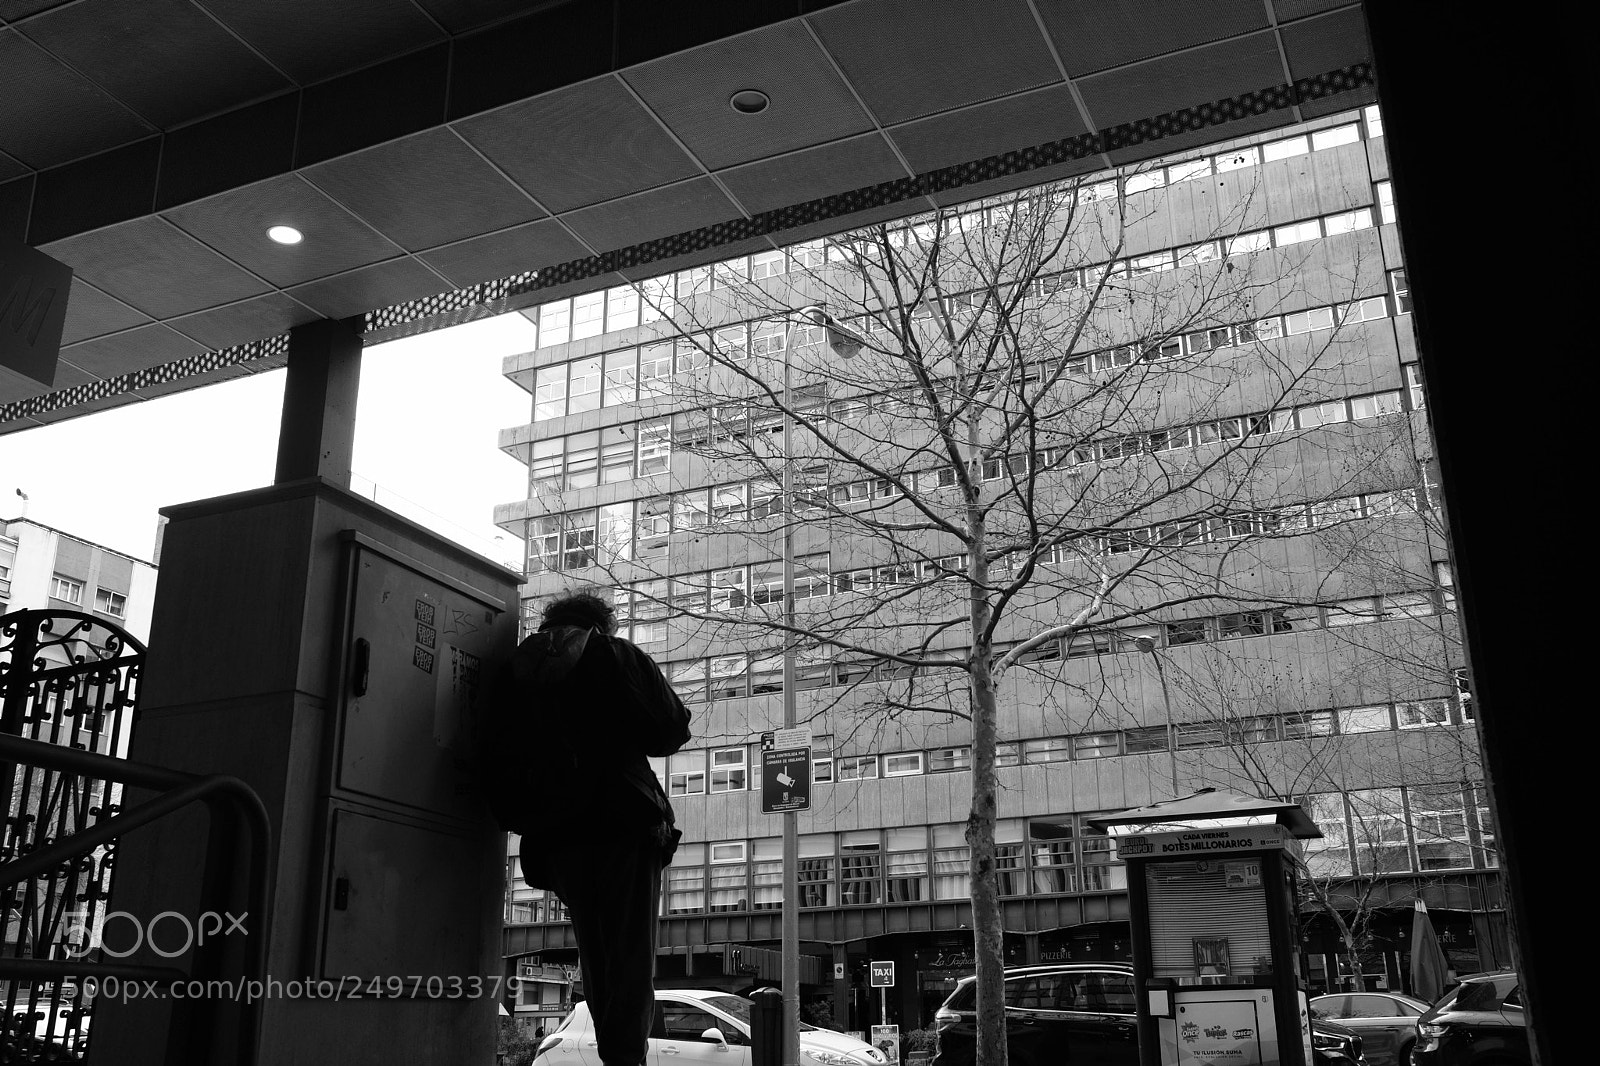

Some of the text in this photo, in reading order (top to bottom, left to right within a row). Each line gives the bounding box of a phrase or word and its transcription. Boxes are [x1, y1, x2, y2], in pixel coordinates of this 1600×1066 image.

[1183, 831, 1230, 841] CADA VIERNES
[1162, 839, 1253, 853] BOTES MILLONARIOS
[1246, 865, 1258, 876] 10
[1040, 951, 1072, 960] PIZZERIE
[873, 968, 892, 976] TAXI
